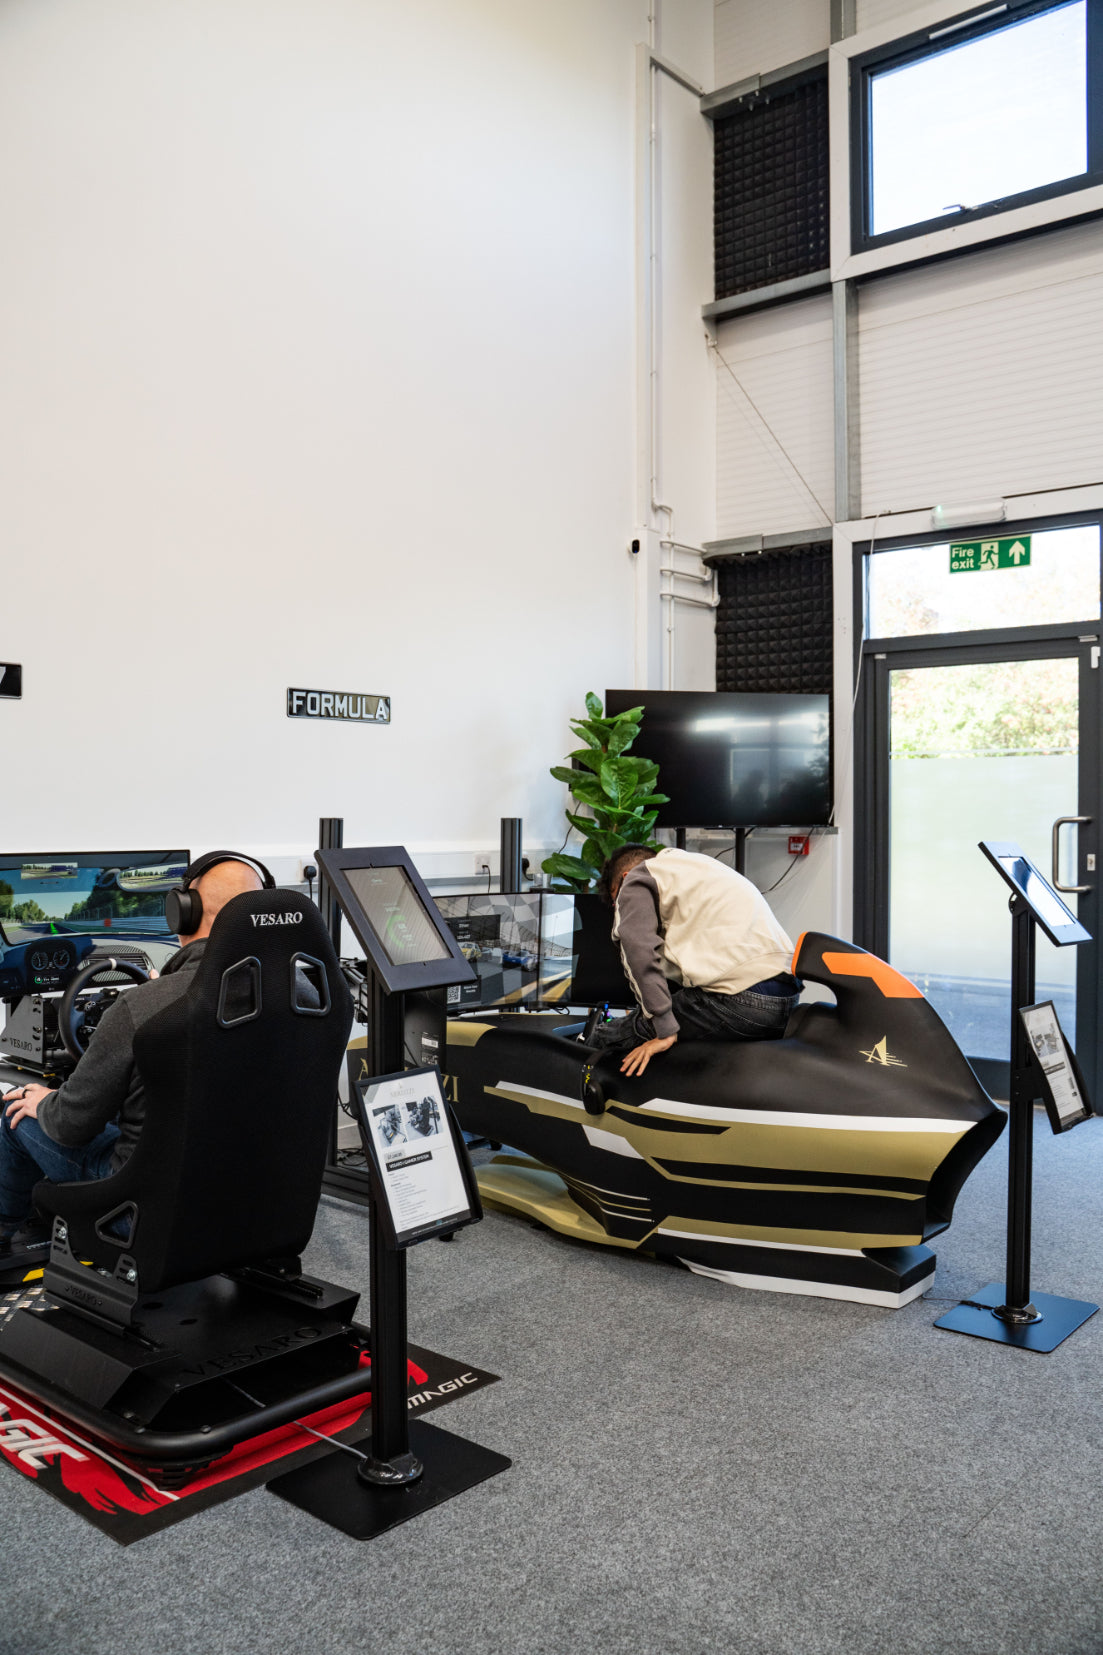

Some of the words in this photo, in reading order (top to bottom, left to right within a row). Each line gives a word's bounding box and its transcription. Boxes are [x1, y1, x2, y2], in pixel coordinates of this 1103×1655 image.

[952, 547, 974, 558] Fire
[952, 558, 974, 570] exit
[292, 691, 388, 720] FORMULA
[250, 911, 303, 927] VESARO
[182, 1326, 321, 1376] VESARO
